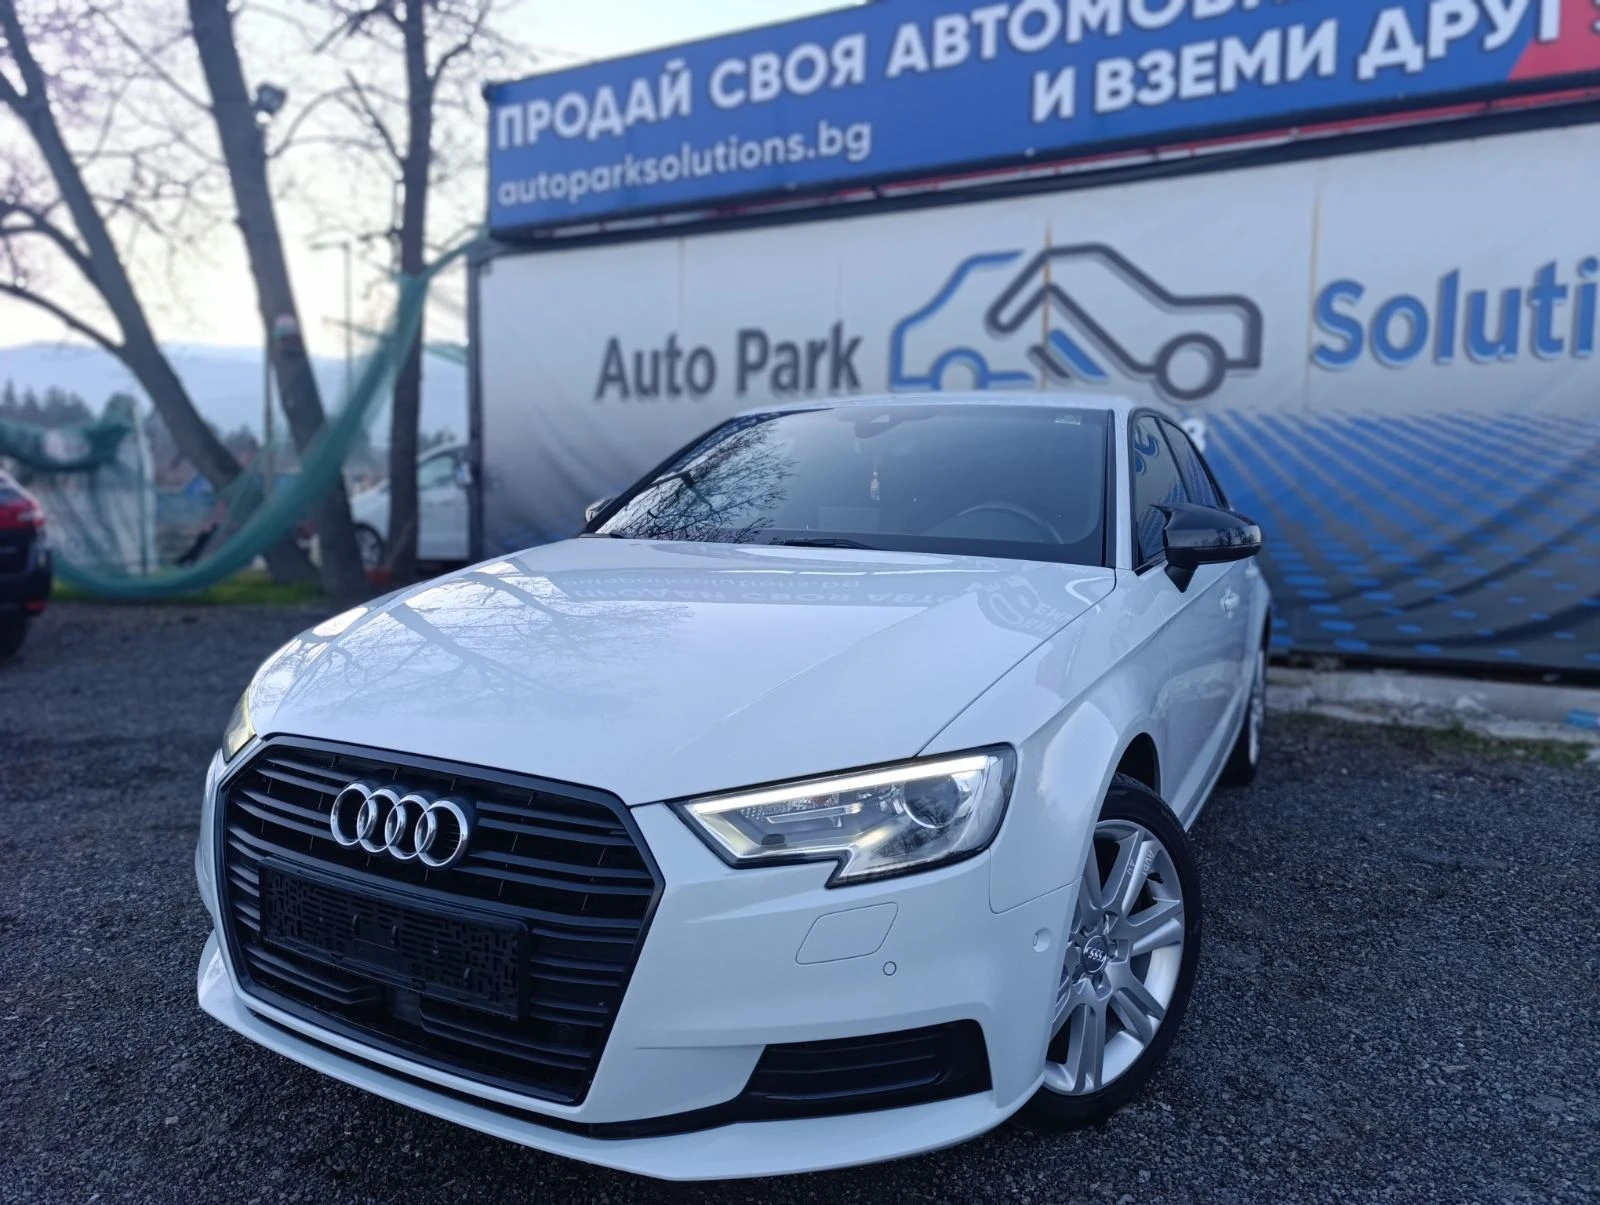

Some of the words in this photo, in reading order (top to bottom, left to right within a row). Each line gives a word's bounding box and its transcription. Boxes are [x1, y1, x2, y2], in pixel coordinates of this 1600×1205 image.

[498, 58, 692, 149] ПРОДАЙ
[709, 33, 866, 109] СВОЯ
[1032, 69, 1075, 122] И
[1094, 18, 1338, 113] ВЗЕМИ
[498, 121, 871, 206] autoparksolutions.bg
[597, 334, 716, 400] Auto
[736, 321, 862, 395] Park
